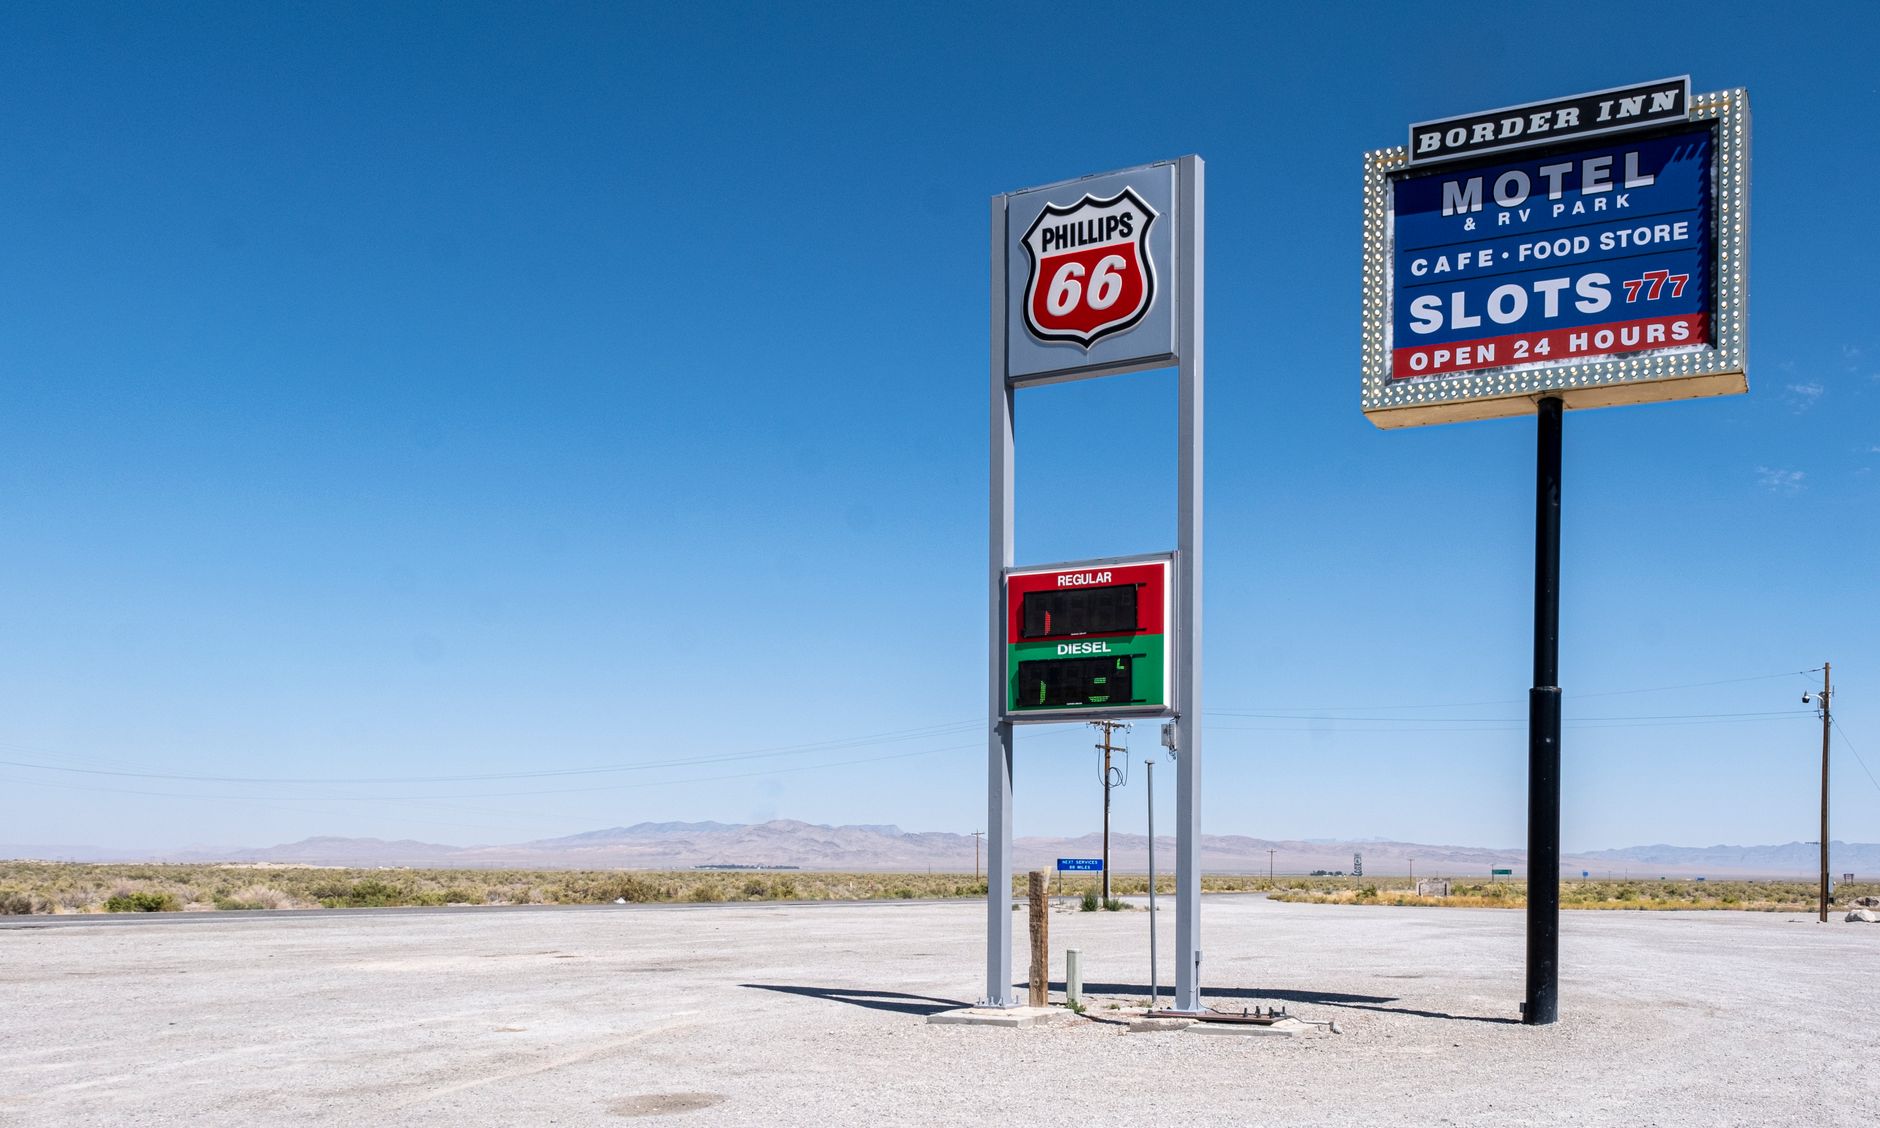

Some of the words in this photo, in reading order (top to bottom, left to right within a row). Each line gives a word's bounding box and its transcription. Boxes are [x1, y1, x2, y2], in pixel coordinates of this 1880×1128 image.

[1417, 107, 1580, 153] BORDER
[1597, 89, 1679, 121] INN
[1442, 151, 1655, 217] MOTEL
[1042, 212, 1133, 253] PHILLIPS
[1463, 217, 1476, 231] &
[1498, 208, 1531, 226] RV
[1553, 193, 1630, 218] PARK
[1411, 249, 1493, 276] CAFE
[1519, 236, 1590, 262] FOOD
[1600, 221, 1689, 250] STORE
[1046, 254, 1126, 317] 66
[1409, 272, 1612, 334] SLOTS
[1623, 269, 1690, 303] 777
[1409, 344, 1495, 371] OPEN
[1513, 337, 1550, 359] 24
[1569, 321, 1690, 352] HOURS
[1057, 572, 1112, 586] REGULAR
[1057, 641, 1111, 656] DIESEL
